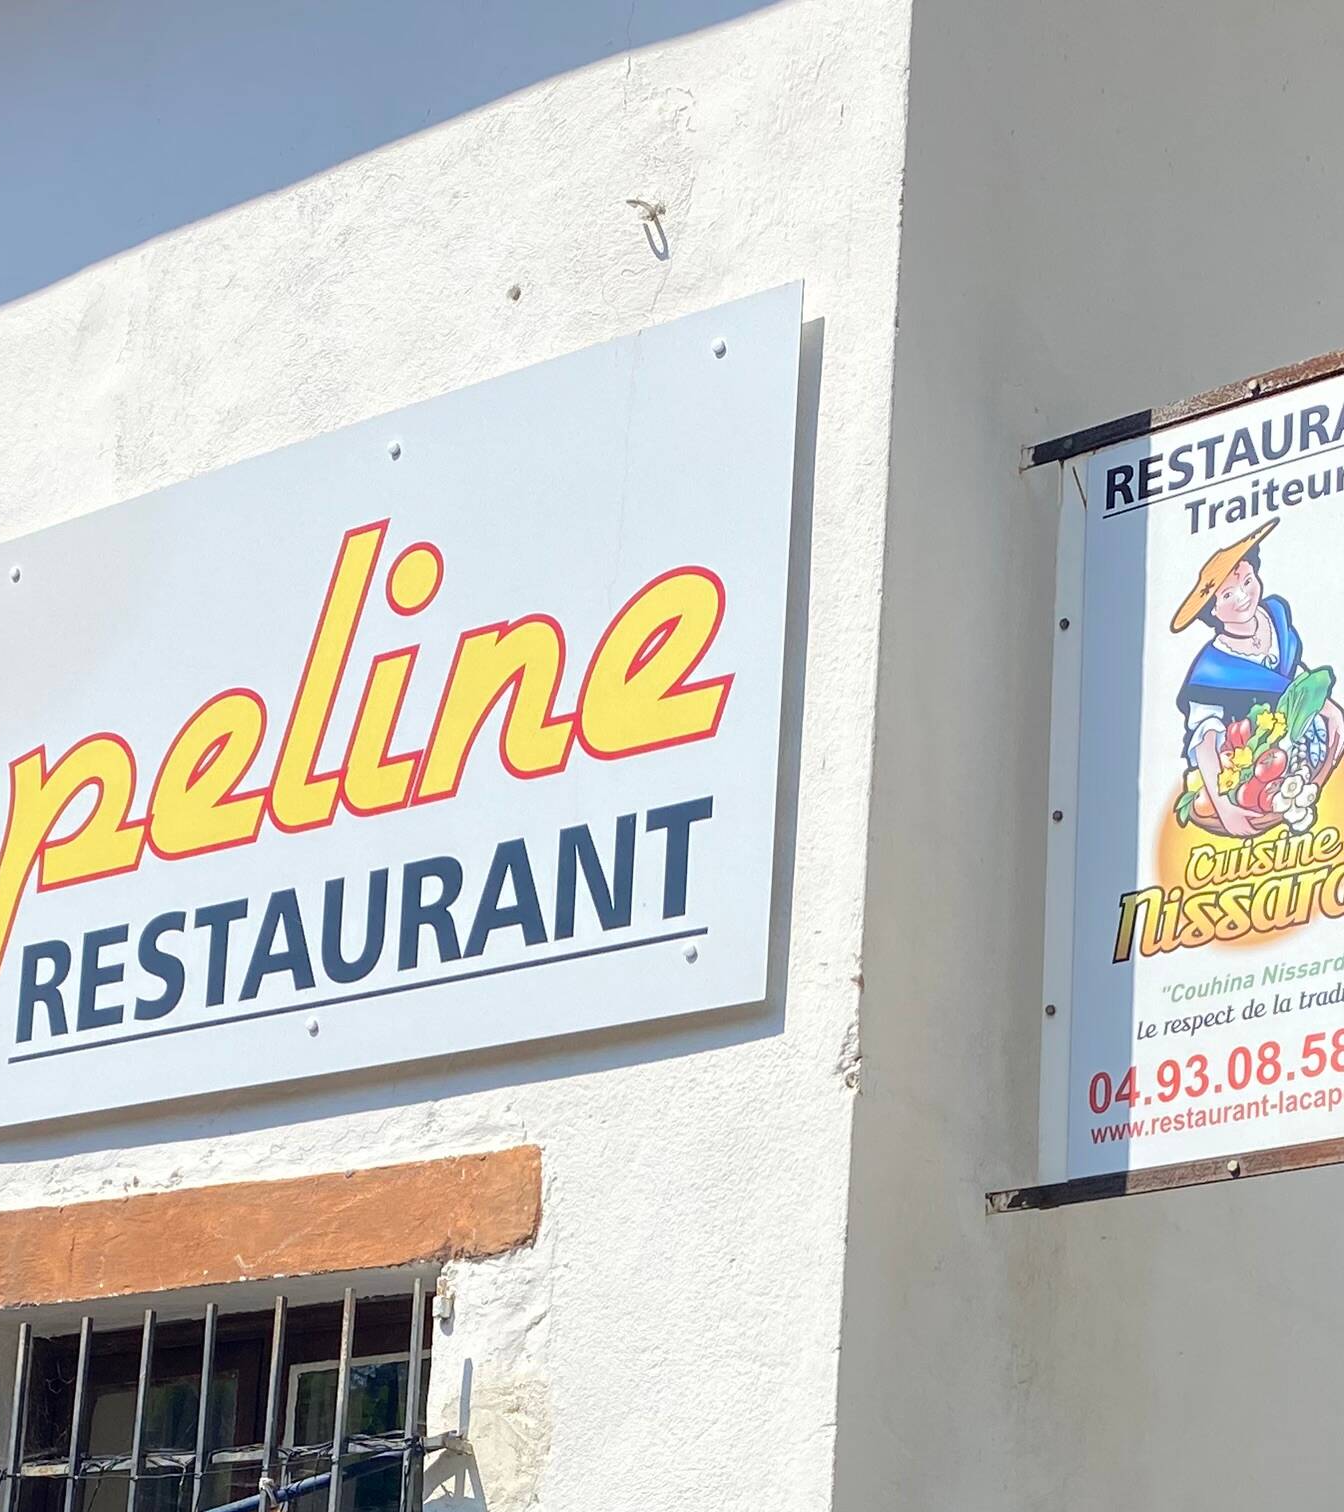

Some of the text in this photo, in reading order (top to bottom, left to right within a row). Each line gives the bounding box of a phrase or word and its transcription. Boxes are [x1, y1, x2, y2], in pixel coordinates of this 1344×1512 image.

[1185, 826, 1342, 888] Cuisine
[16, 796, 713, 1043] RESTAURANT
[1163, 1006, 1235, 1036] respect
[1242, 997, 1266, 1020] de
[1272, 994, 1291, 1015] la
